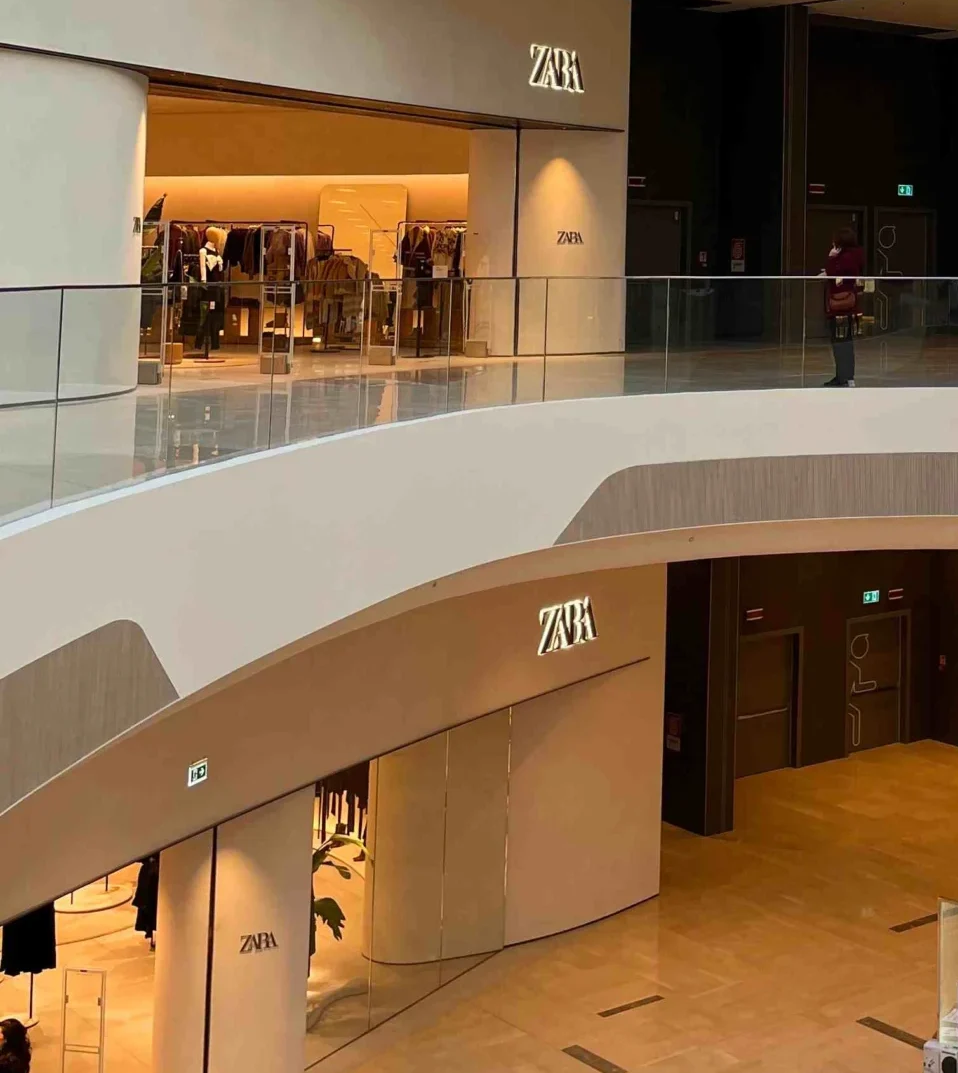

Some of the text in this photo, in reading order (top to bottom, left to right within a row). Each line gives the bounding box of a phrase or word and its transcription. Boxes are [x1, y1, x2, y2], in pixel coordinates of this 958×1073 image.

[528, 43, 585, 93] ZARA
[556, 230, 585, 245] ZARA
[537, 595, 599, 656] ZARA
[239, 931, 279, 955] ZARA
